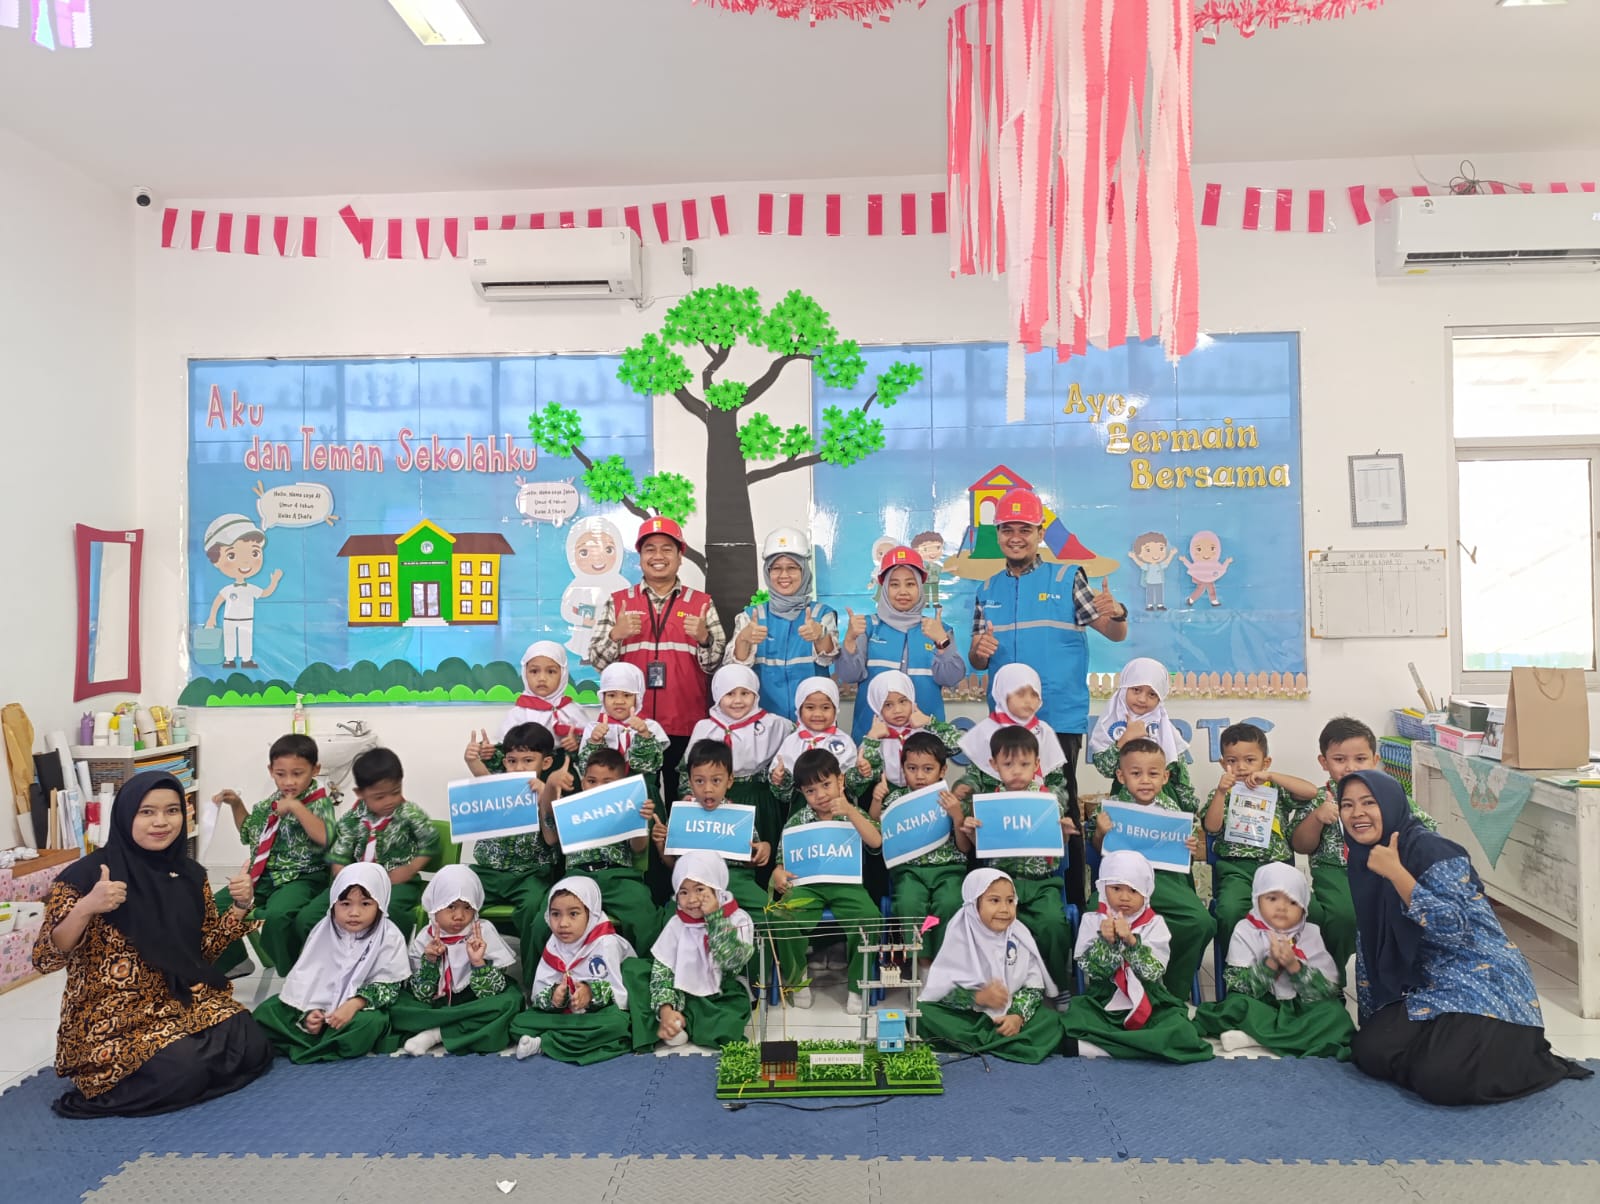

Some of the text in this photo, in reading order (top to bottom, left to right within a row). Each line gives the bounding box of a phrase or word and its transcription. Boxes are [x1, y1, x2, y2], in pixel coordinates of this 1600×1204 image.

[206, 383, 264, 430] Aku
[1063, 382, 1137, 423] Ayo,
[244, 426, 538, 473] dan Teman Sekolahku
[1106, 417, 1259, 454] Bermain
[1130, 458, 1291, 490] Bersama
[451, 793, 536, 817] SOSIALISASI
[571, 799, 636, 826] BAHAYA
[685, 819, 737, 837] LISTRIK
[882, 829, 894, 842] AL
[896, 809, 938, 834] AZHAR
[1002, 815, 1032, 831] PLN
[790, 843, 854, 863] TK ISLAM
